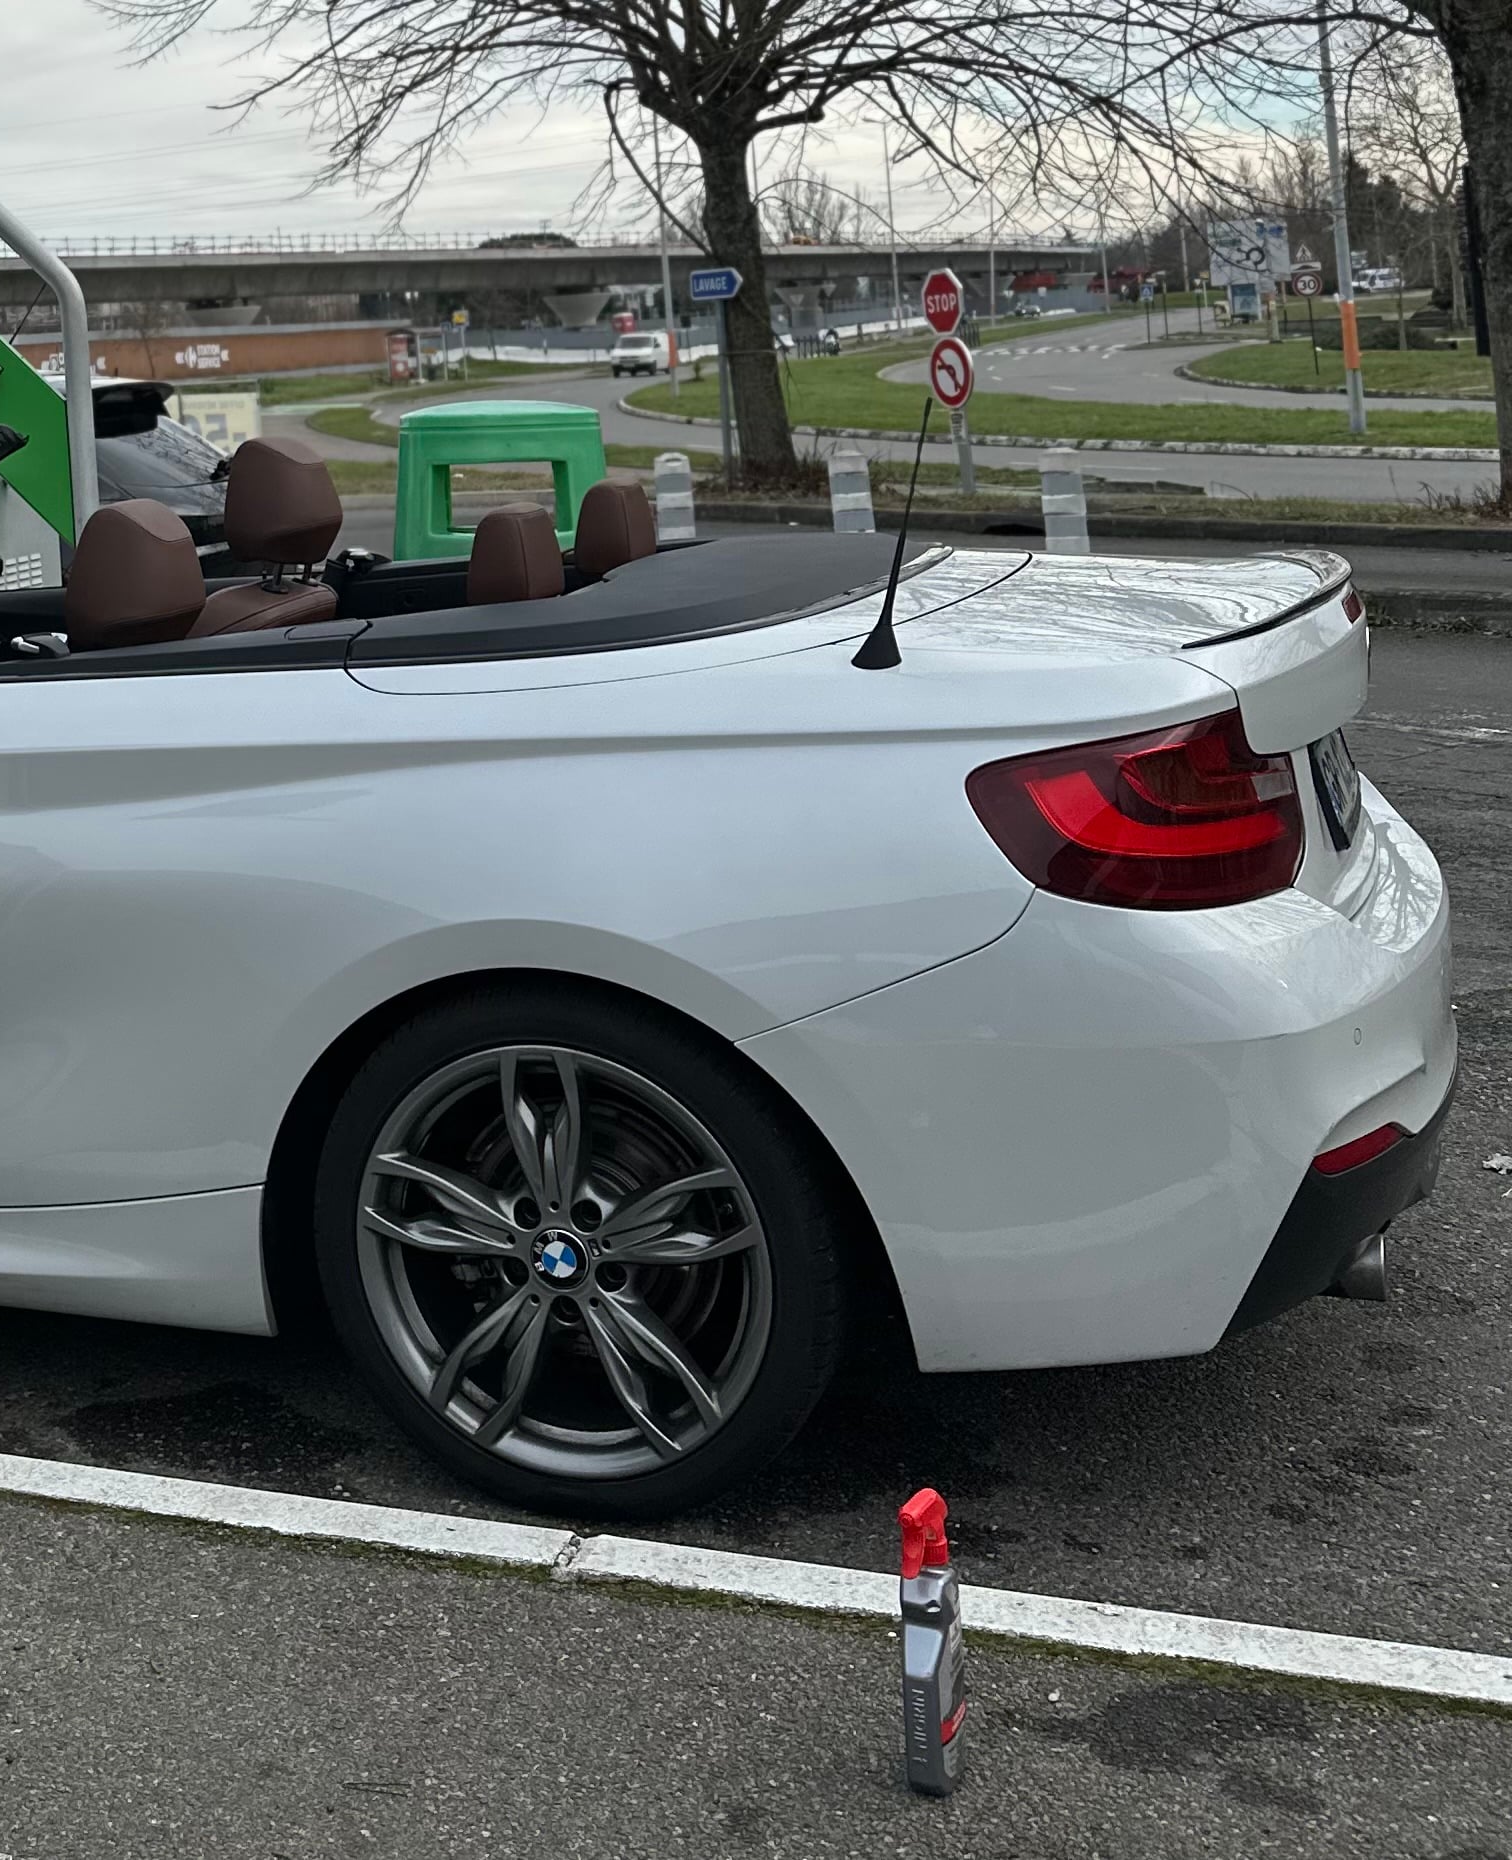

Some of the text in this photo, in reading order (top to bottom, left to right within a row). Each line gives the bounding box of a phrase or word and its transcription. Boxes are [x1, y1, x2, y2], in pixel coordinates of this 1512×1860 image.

[693, 276, 728, 292] LAVAGE
[1299, 280, 1316, 290] 30
[927, 293, 956, 313] STOP
